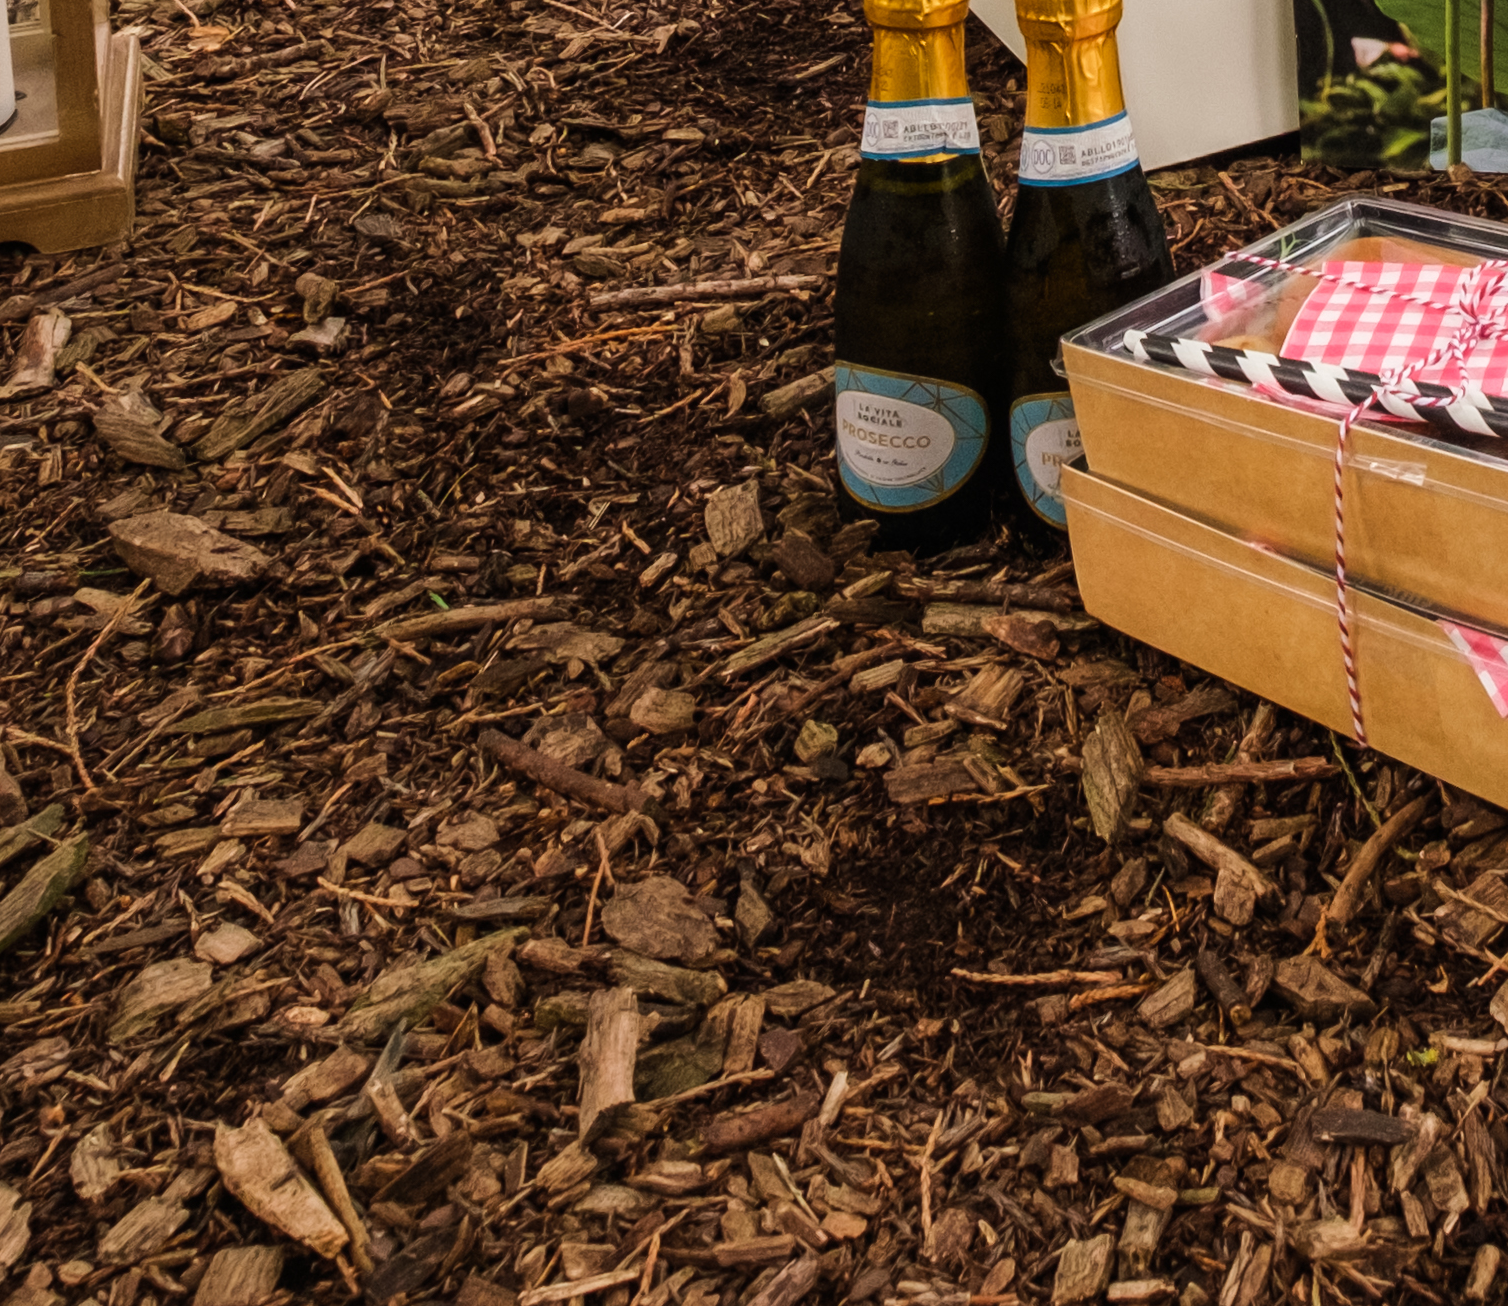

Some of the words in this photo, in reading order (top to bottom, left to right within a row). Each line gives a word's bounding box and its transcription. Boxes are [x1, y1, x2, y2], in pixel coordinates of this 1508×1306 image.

[1033, 149, 1051, 166] DOC
[858, 403, 870, 412] LA
[874, 407, 900, 418] VITA
[858, 411, 903, 428] SOCIALE
[842, 418, 931, 449] PROSECCO
